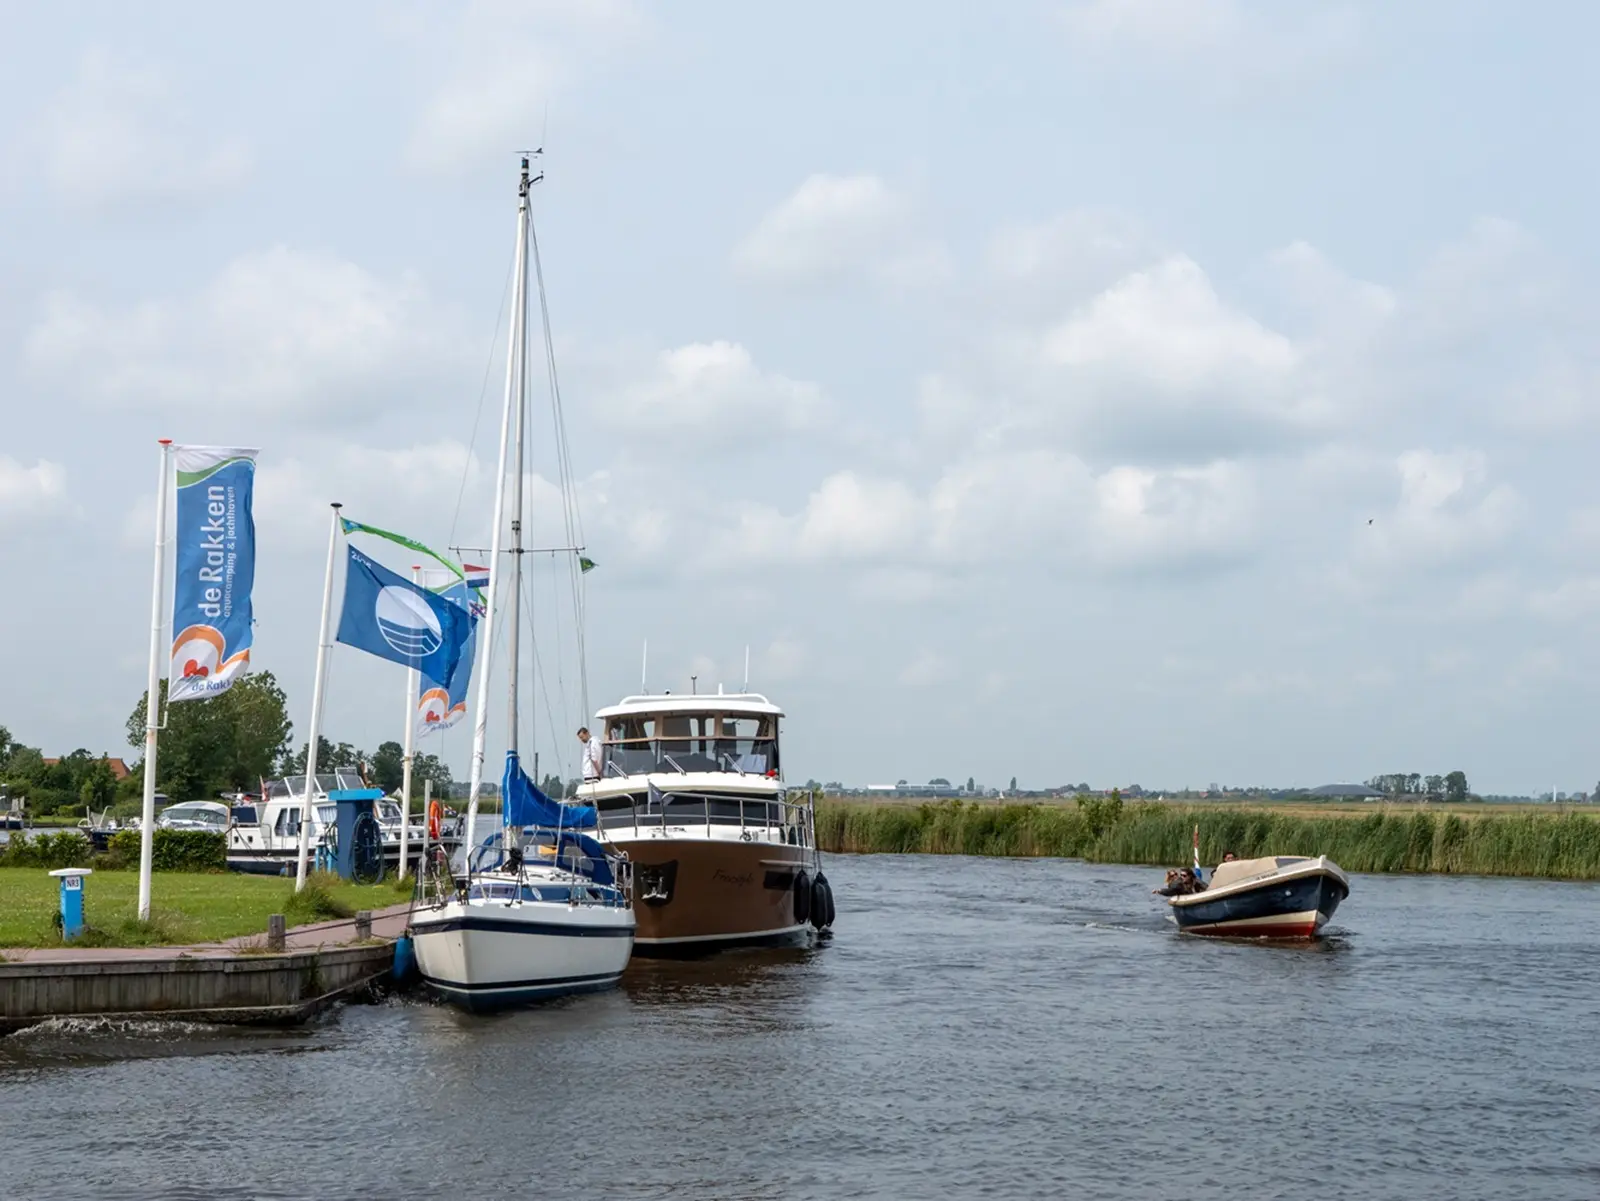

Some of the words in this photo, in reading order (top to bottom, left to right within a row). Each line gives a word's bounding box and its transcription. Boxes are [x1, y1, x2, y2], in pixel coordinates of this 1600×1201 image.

[198, 485, 225, 582] Rakken
[225, 486, 237, 540] jachthaven
[226, 542, 236, 550] &
[197, 588, 221, 617] de
[223, 552, 237, 618] aquacamping
